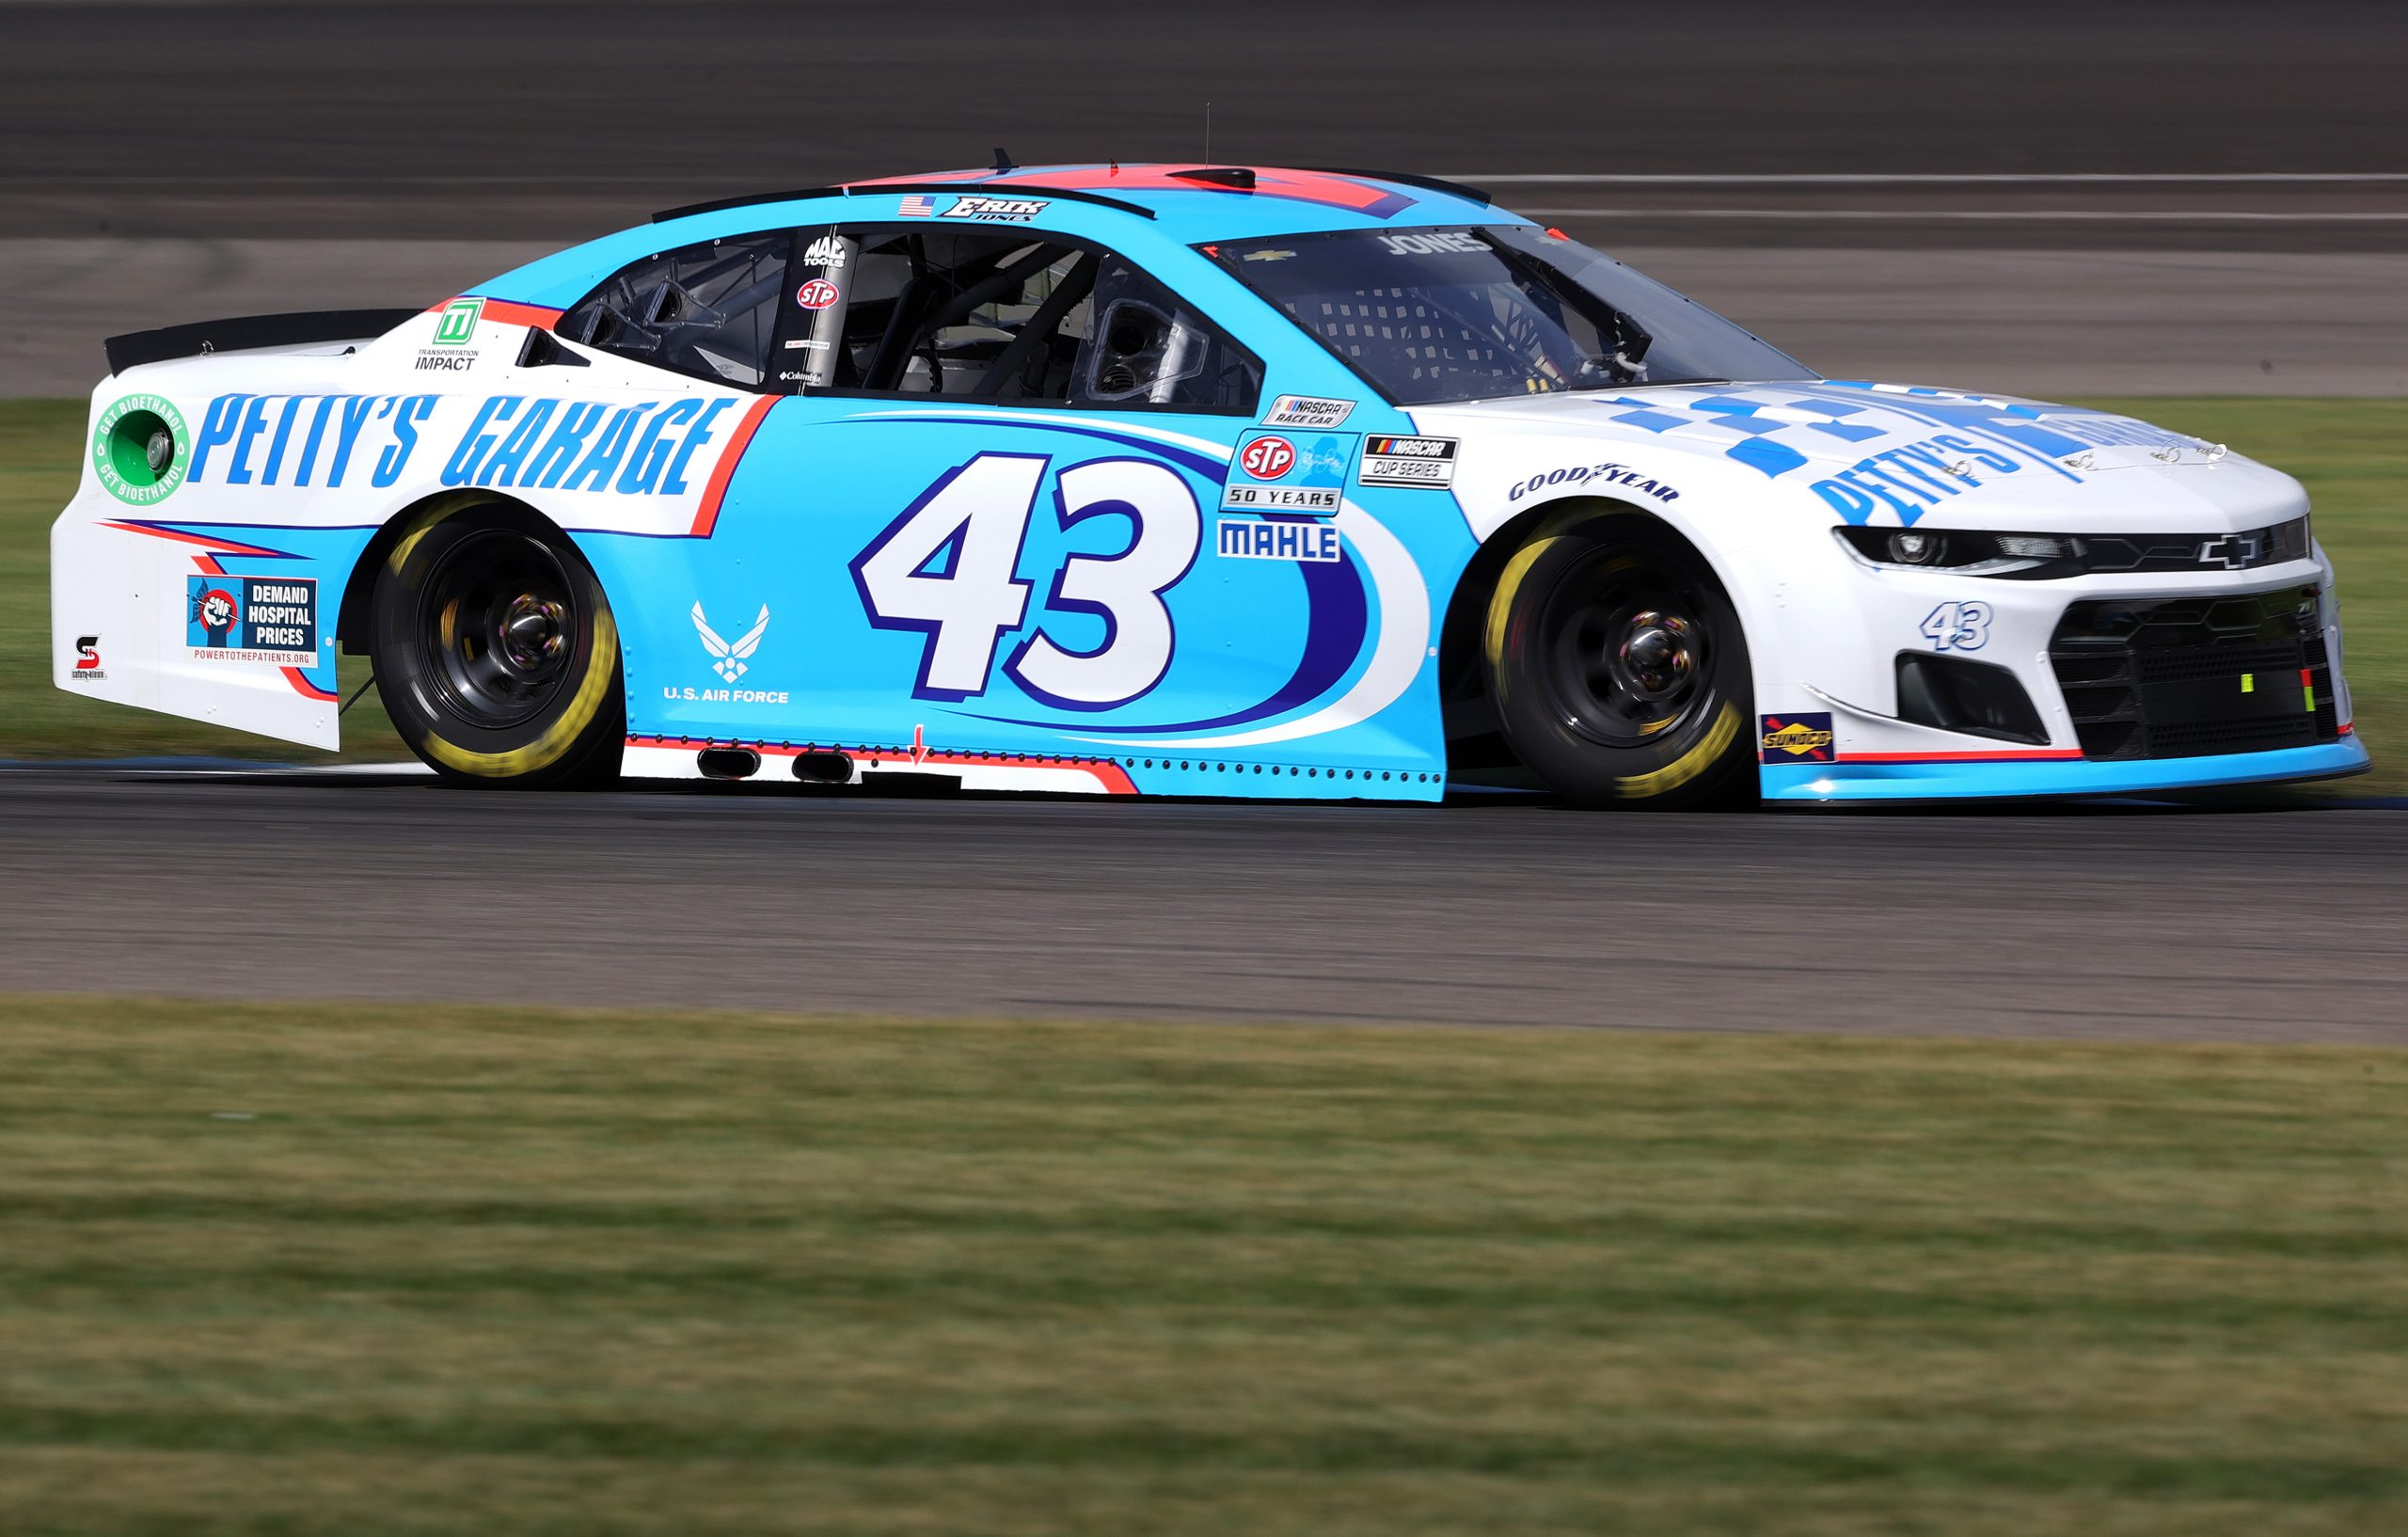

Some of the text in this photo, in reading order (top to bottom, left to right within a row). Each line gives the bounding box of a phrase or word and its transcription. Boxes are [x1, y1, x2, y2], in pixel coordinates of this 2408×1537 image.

[804, 236, 845, 260] MAC
[1377, 233, 1493, 256] JONES
[803, 257, 845, 268] TOOLS
[800, 282, 834, 305] STP
[414, 357, 475, 371] IMPACT
[786, 372, 821, 384] Columbia
[100, 396, 182, 436] GET BIOETHANOL
[1295, 400, 1342, 415] NASCAR
[1275, 413, 1333, 424] RACE CAR
[186, 393, 739, 495] PETTY'S GARAGE
[1392, 439, 1446, 456] NASCAR
[1245, 441, 1292, 473] STP
[1373, 461, 1442, 477] CUP SERIES
[101, 464, 182, 501] GET BIOETHANOL
[1229, 489, 1336, 506] 50 YEARS
[1221, 523, 1337, 559] MAHLE
[848, 451, 1203, 712] 43
[252, 585, 309, 604] DEMAND
[248, 606, 311, 625] HOSPITAL
[256, 626, 304, 645] PRICES
[1920, 600, 1994, 652] 43
[195, 650, 309, 663] POWERTOTHEPATIENTS.ORG
[702, 689, 730, 702] AIR
[733, 690, 789, 704] FORCE
[1767, 732, 1829, 746] SUNOCO
